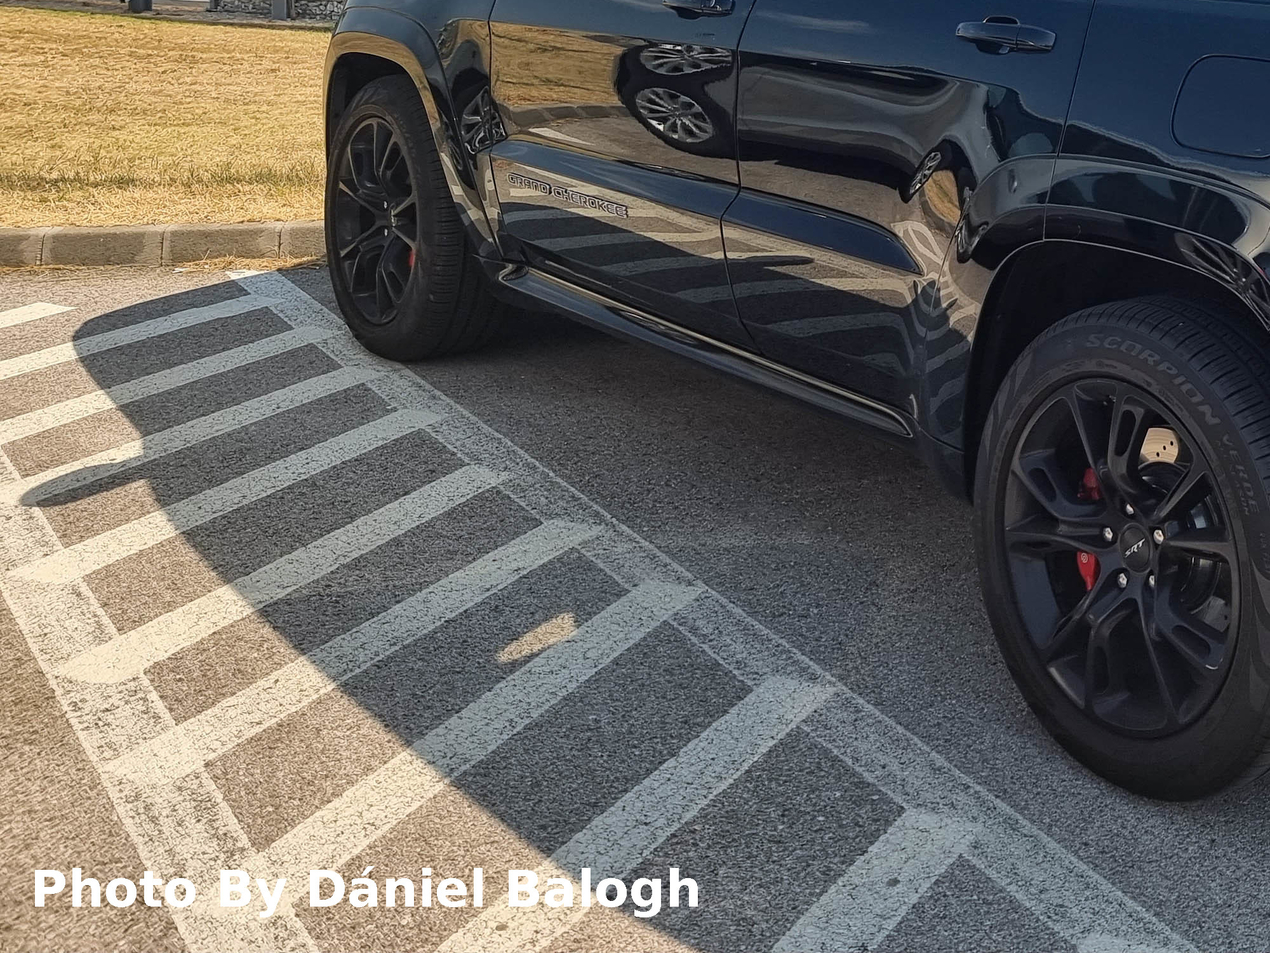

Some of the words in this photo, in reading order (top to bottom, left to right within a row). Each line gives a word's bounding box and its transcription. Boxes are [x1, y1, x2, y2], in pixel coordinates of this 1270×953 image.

[508, 172, 552, 195] GRAND
[553, 186, 628, 219] CHEROKEE
[1086, 333, 1221, 425] SCORPION
[1124, 538, 1145, 558] SRT
